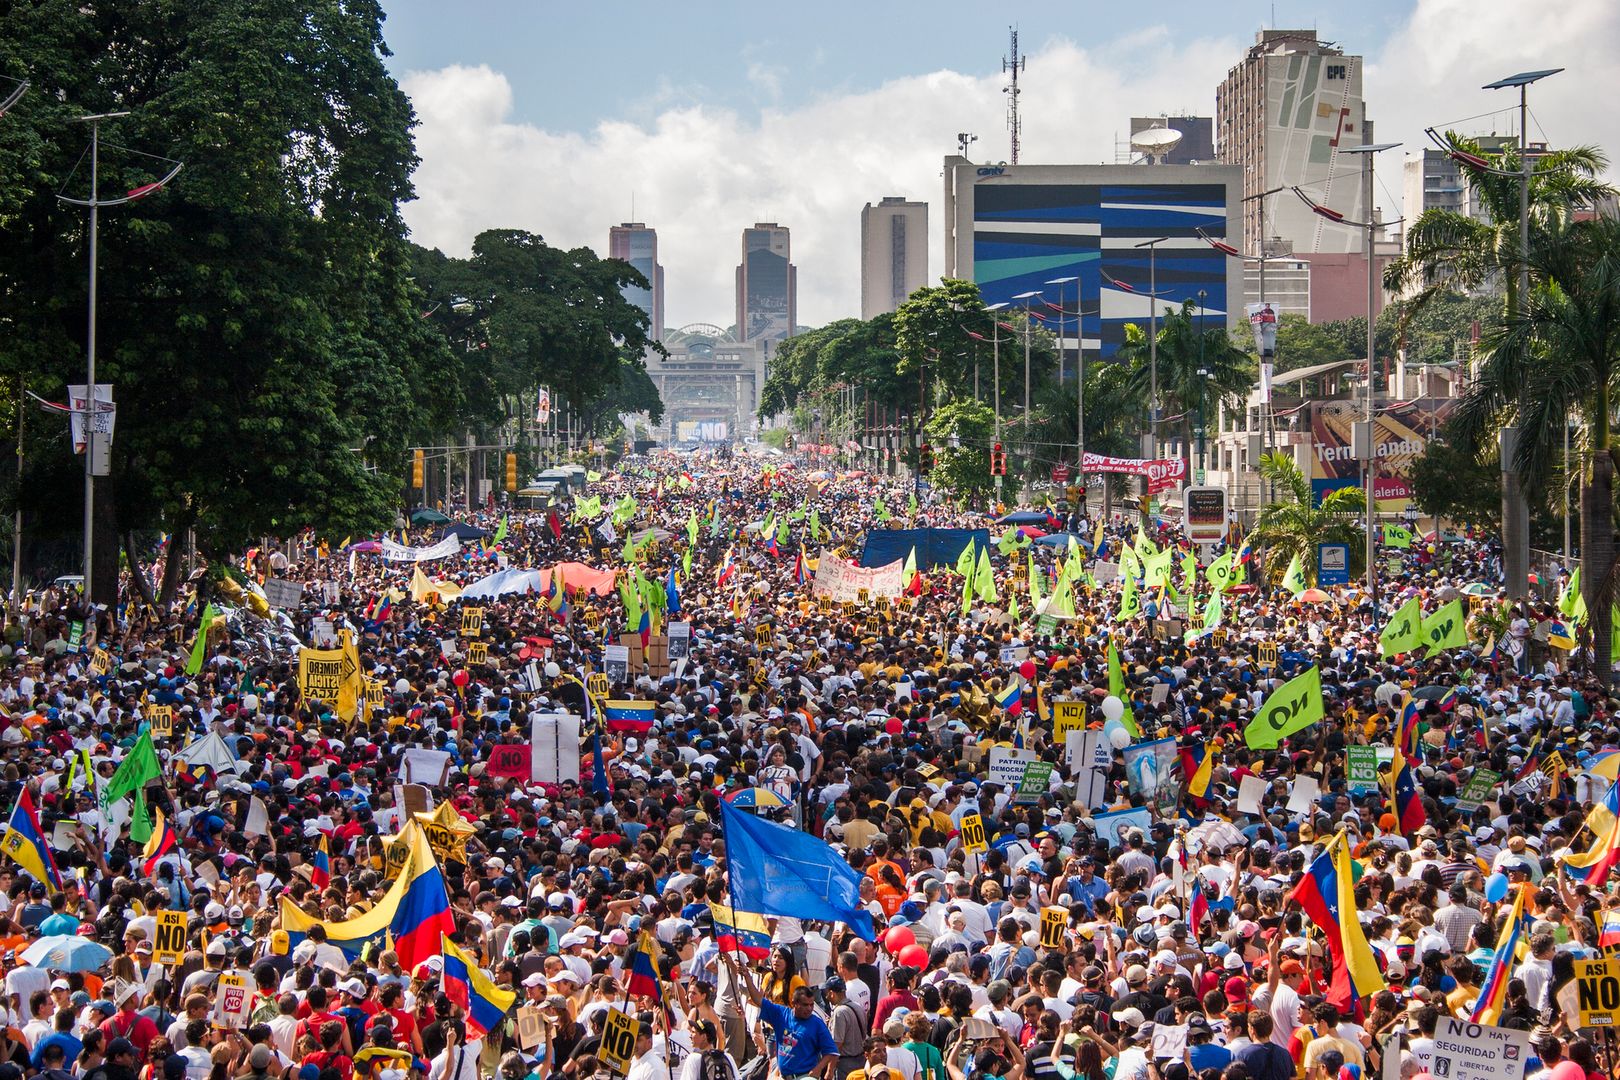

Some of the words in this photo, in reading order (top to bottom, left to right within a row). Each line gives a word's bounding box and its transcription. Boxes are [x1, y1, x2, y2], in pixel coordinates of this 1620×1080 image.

[1327, 66, 1345, 79] CPC
[701, 423, 727, 440] NO
[1374, 487, 1405, 497] alería
[463, 616, 480, 629] NO
[468, 650, 486, 663] NO
[1260, 649, 1276, 660] NO
[590, 679, 607, 694] NO
[367, 690, 382, 702] NO
[152, 714, 171, 729] NO
[501, 752, 521, 766] NO
[1351, 768, 1375, 779] NO
[1022, 783, 1043, 792] NO
[1464, 789, 1485, 800] NO
[962, 824, 984, 846] NO
[156, 925, 185, 952] NO
[1041, 920, 1066, 945] NO
[1586, 962, 1607, 976] ASÍ
[1579, 977, 1620, 1010] NO
[228, 999, 240, 1007] NO
[1448, 1020, 1482, 1038] NO
[1489, 1031, 1511, 1041] HAY
[603, 1026, 635, 1060] NO
[1436, 1041, 1496, 1059] SEGURIDAD
[1460, 1061, 1495, 1073] LIBERTAD
